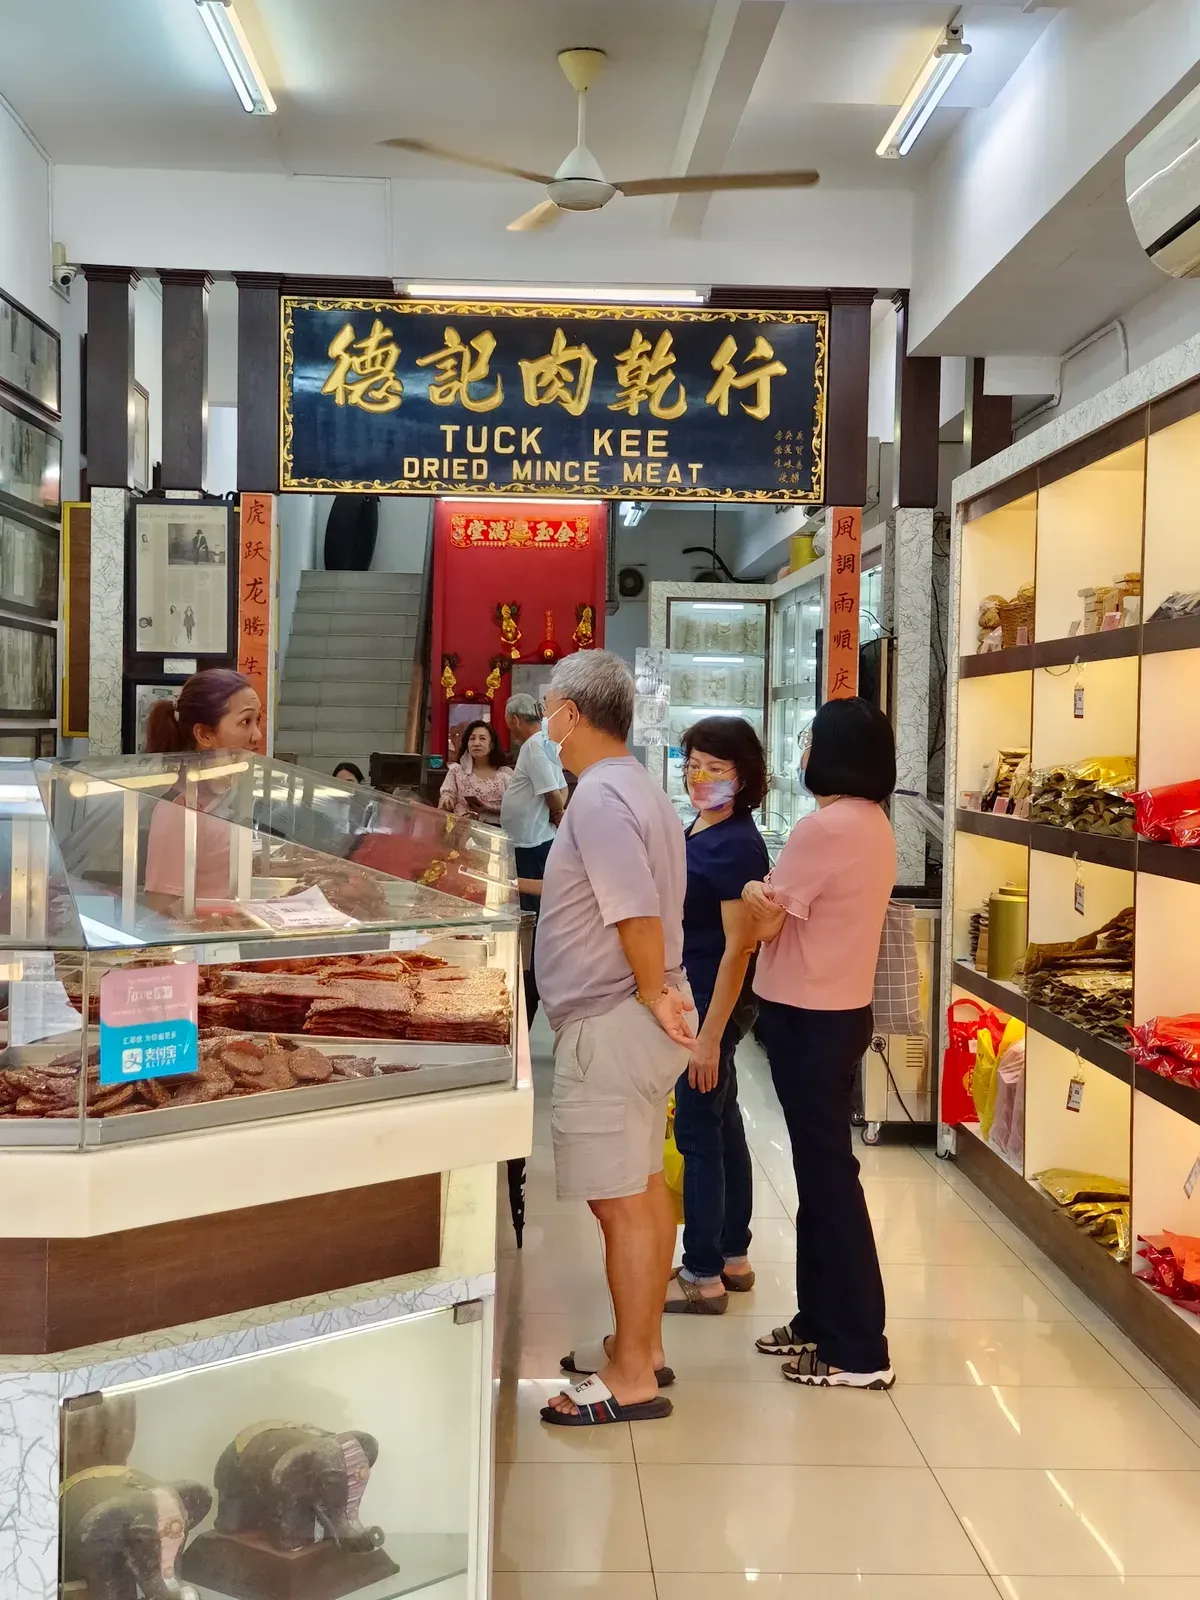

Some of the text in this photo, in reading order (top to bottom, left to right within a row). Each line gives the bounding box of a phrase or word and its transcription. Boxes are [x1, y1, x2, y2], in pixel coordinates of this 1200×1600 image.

[321, 318, 788, 421] 德記肉乾行
[440, 424, 669, 458] TUCK KEE
[403, 457, 704, 484] DRIED MINCE MEAT
[144, 1045, 177, 1062] 支付宝
[145, 1058, 176, 1068] ALIPAY
